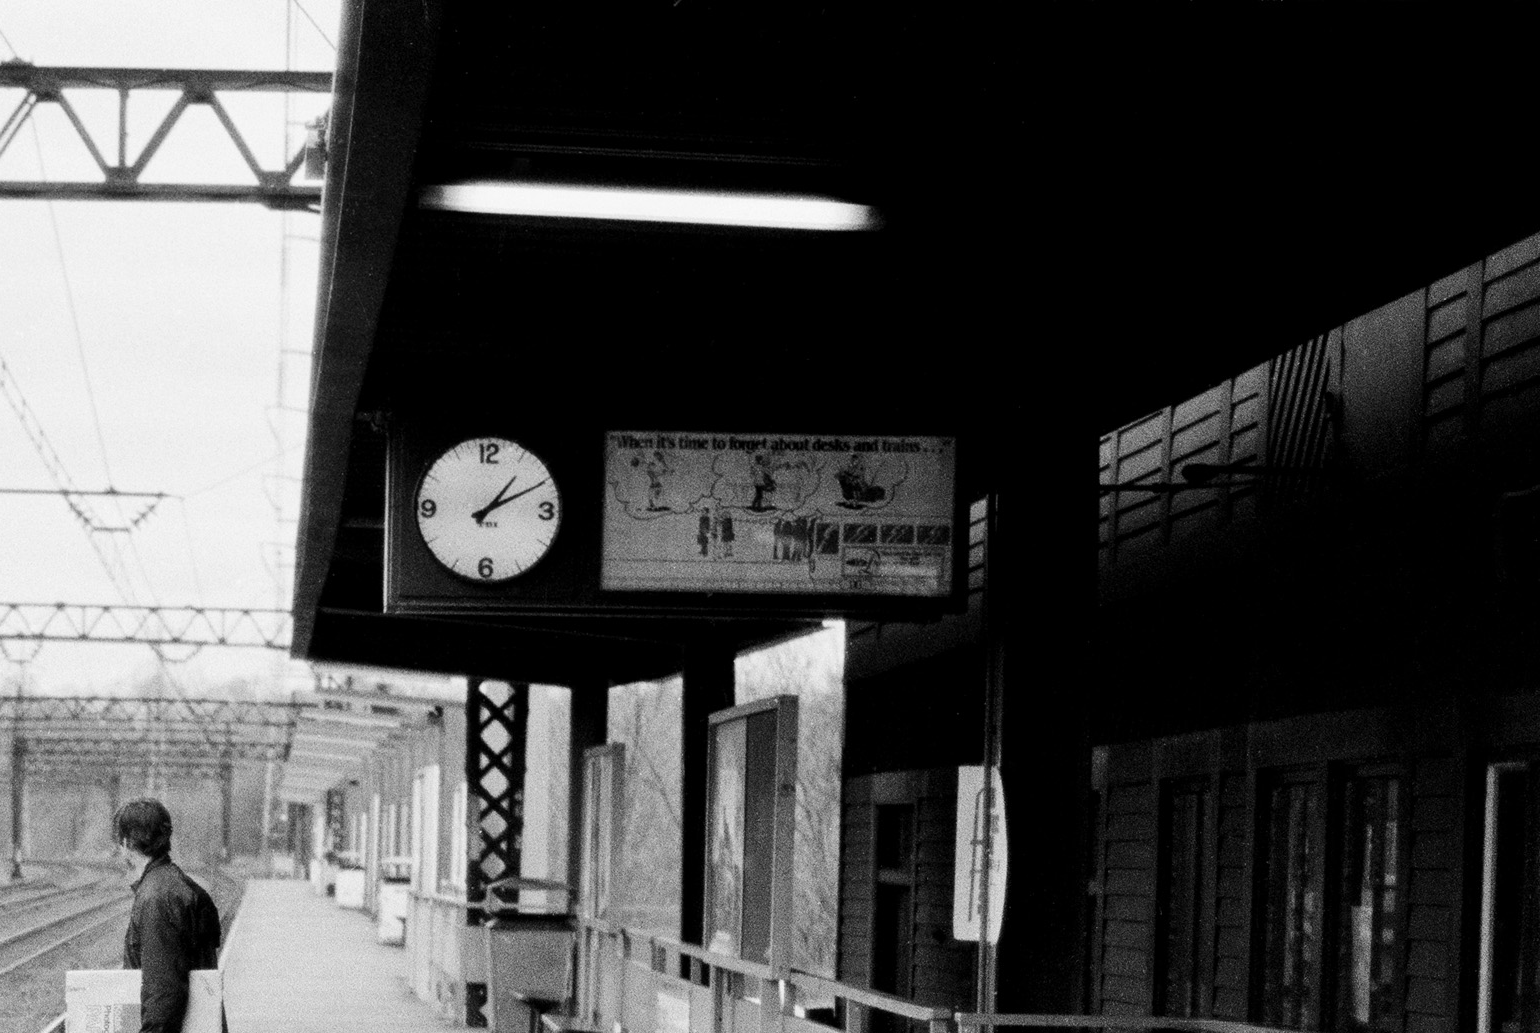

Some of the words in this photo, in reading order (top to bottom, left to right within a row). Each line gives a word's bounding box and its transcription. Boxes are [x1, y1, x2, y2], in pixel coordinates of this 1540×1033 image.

[479, 443, 500, 465] 12
[678, 436, 710, 450] time
[712, 437, 726, 450] to
[728, 436, 767, 455] forget
[770, 437, 809, 452] about
[812, 438, 851, 452] desks
[853, 438, 878, 452] and
[421, 499, 437, 519] 9
[538, 501, 555, 521] 3
[477, 557, 494, 578] 6
